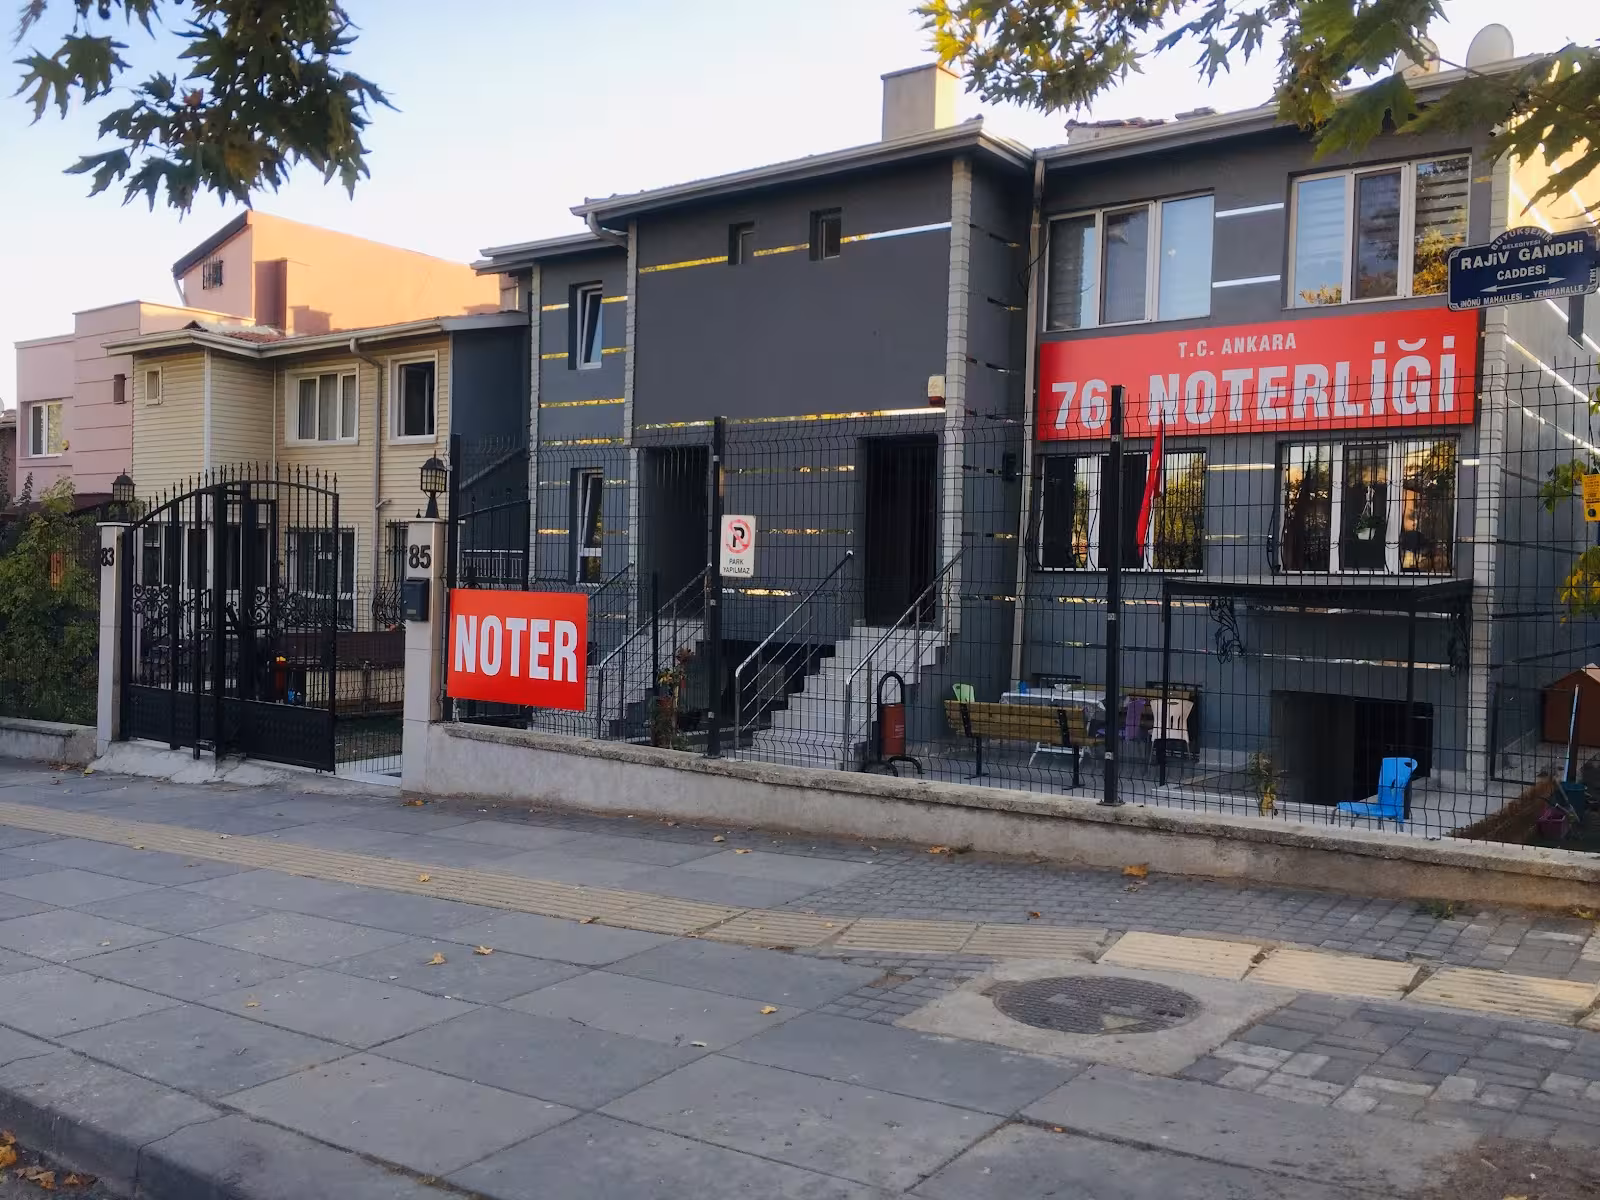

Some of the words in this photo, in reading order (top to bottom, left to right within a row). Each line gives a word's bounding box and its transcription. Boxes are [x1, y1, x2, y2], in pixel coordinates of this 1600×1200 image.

[1178, 340, 1214, 358] T.C.
[1221, 332, 1297, 355] ANKARA
[1051, 378, 1108, 431] 76
[1147, 335, 1457, 428] NOTERLİĞİ
[100, 547, 114, 567] 83
[408, 544, 431, 569] 85
[723, 566, 750, 574] YAPILMAZ
[454, 614, 578, 683] NOTER
